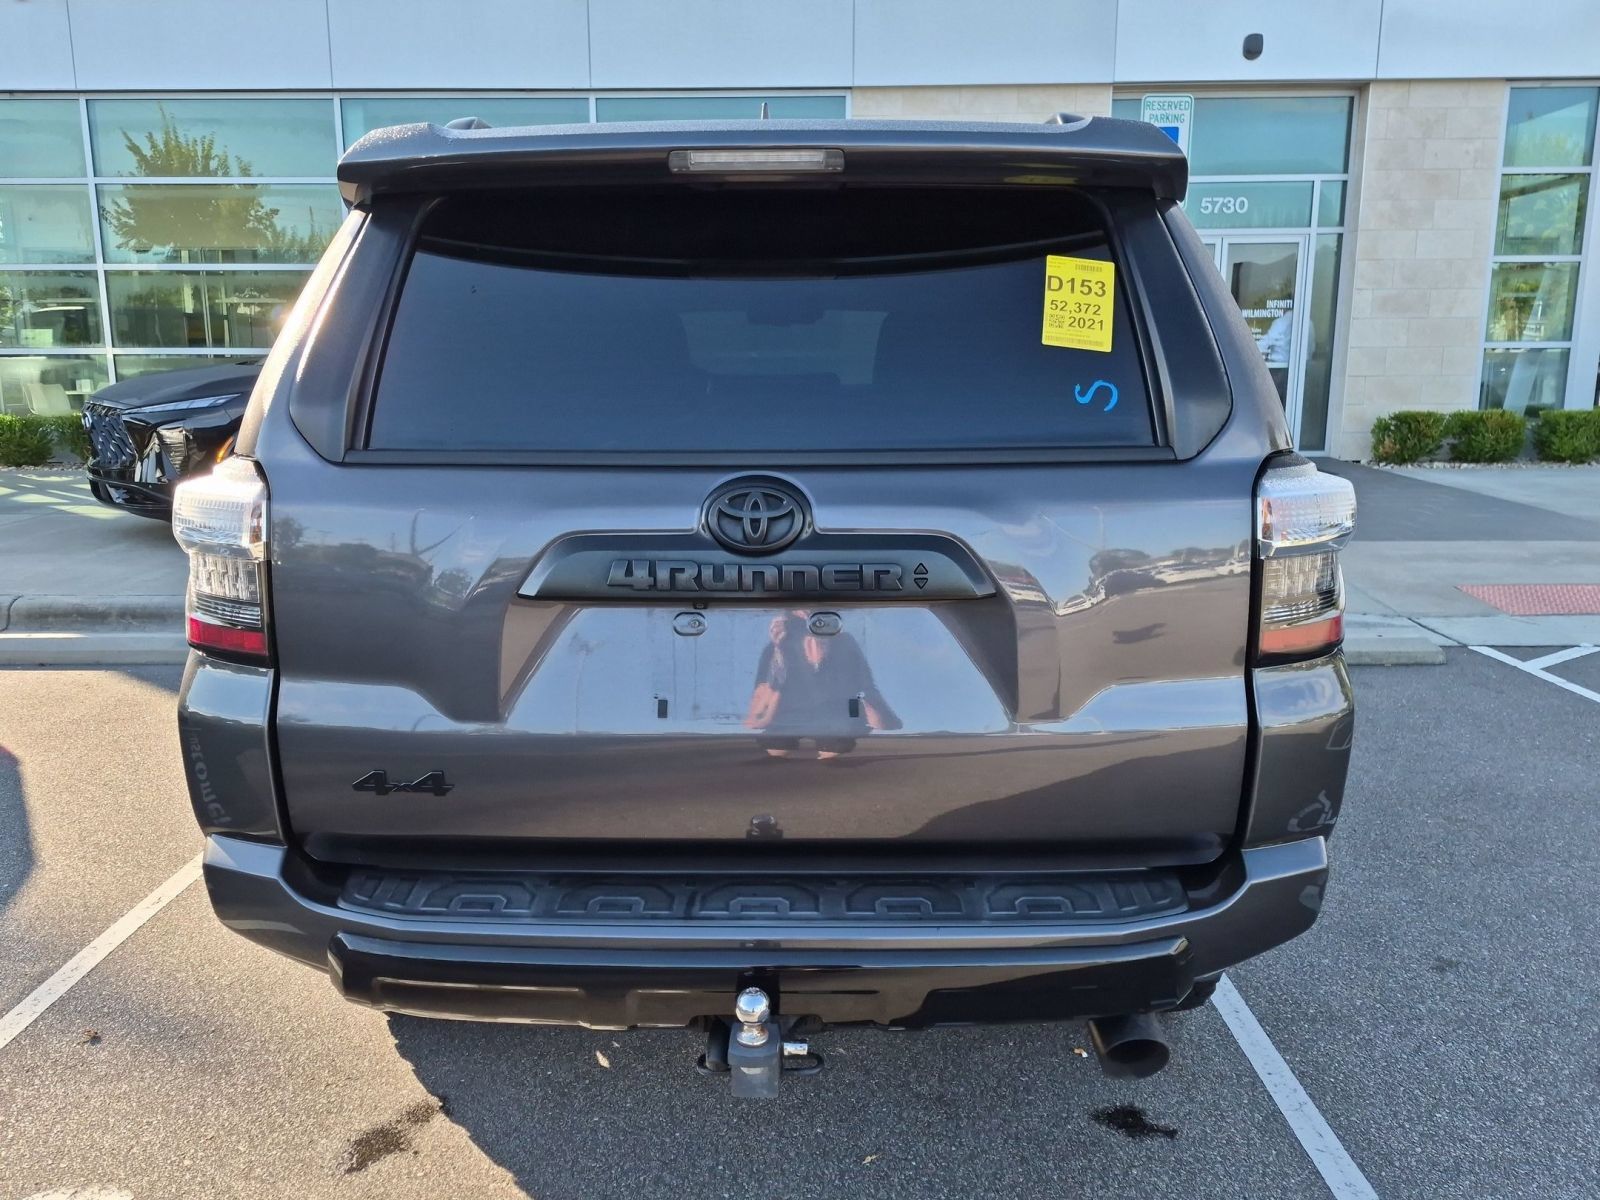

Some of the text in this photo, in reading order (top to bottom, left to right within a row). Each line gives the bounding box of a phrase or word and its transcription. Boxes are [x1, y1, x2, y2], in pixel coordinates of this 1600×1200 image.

[1145, 100, 1190, 111] RESERVED
[1149, 113, 1185, 124] PARKING
[1200, 196, 1249, 214] 5730
[1047, 275, 1107, 297] D153
[1050, 299, 1101, 316] 52,372
[1266, 299, 1293, 308] INFINITI
[1242, 308, 1284, 318] WILMINGTON
[1068, 316, 1104, 331] 2021
[606, 558, 904, 592] 4RUNNER
